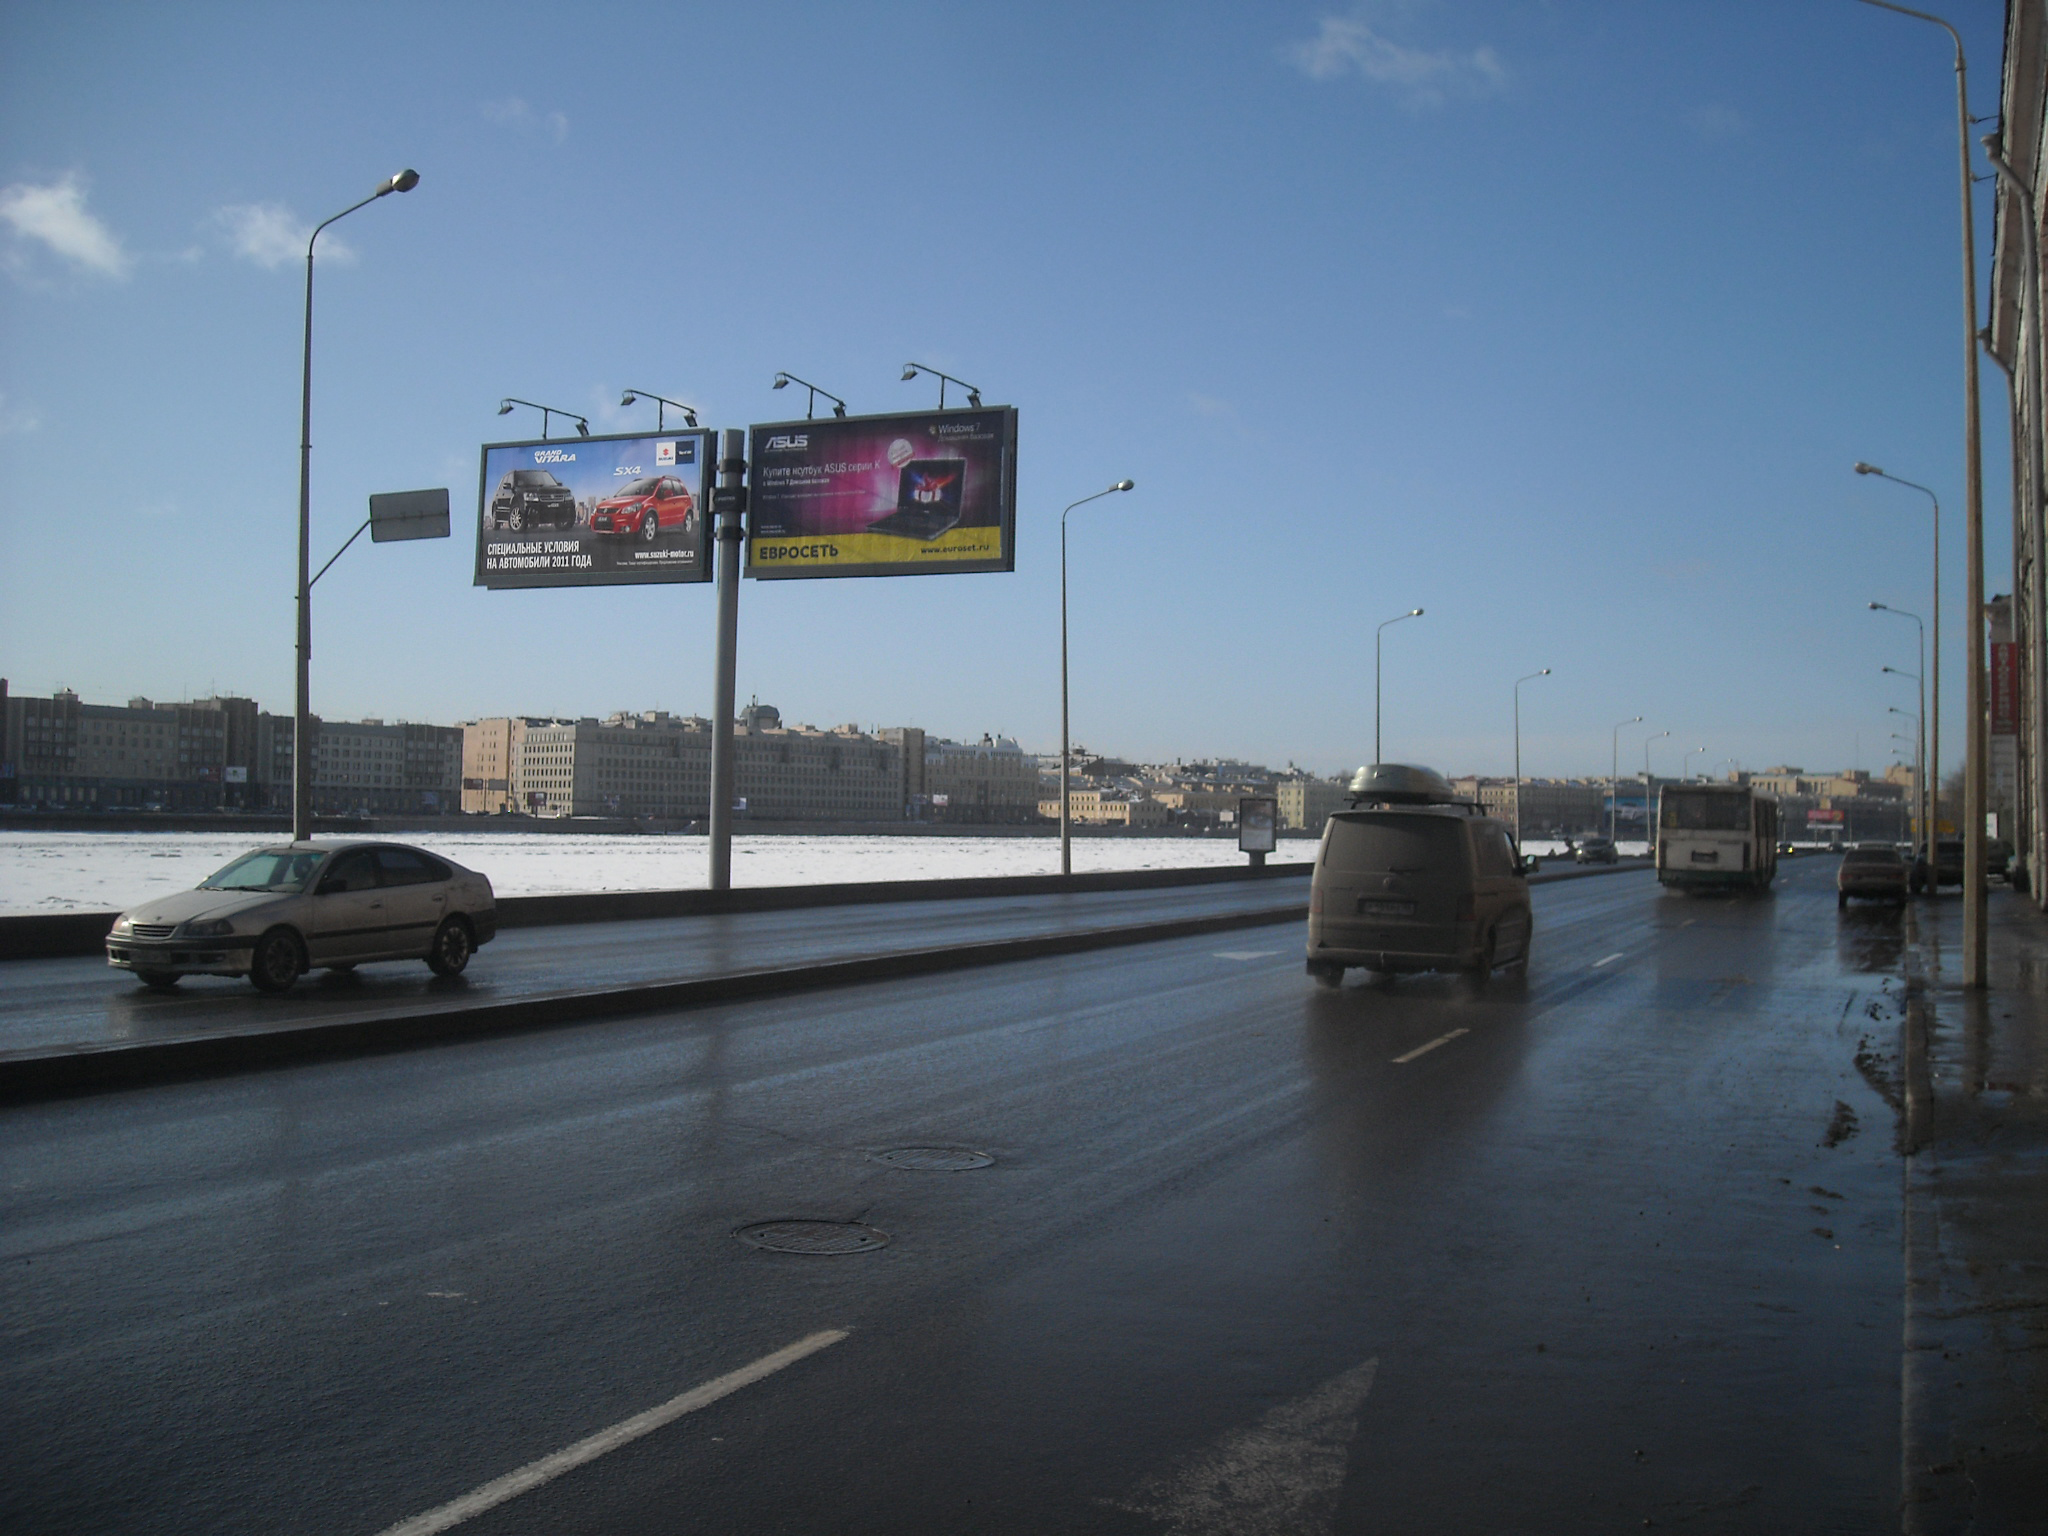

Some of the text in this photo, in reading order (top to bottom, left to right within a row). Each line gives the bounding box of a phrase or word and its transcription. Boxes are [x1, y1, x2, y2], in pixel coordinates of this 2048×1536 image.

[938, 422, 981, 434] Windows 7
[765, 435, 808, 449] ASUS
[534, 449, 562, 457] GRAND
[534, 454, 576, 464] VITARA
[613, 466, 642, 476] SX4
[763, 467, 790, 478] Купите
[792, 465, 822, 476] ноутбук
[824, 462, 847, 473] ASUS
[848, 462, 873, 473] серии
[487, 541, 580, 556] СПЕЦИАЛЬНЫЕ УСЛОВИЯ
[634, 549, 694, 559] www.suzuki-motor.ru
[759, 544, 839, 560] ЕВРОСЕТЬ
[920, 543, 990, 554] www.euroset.ru
[487, 555, 592, 569] НА АВТОМОБИЛИ 2011 ГОДА
